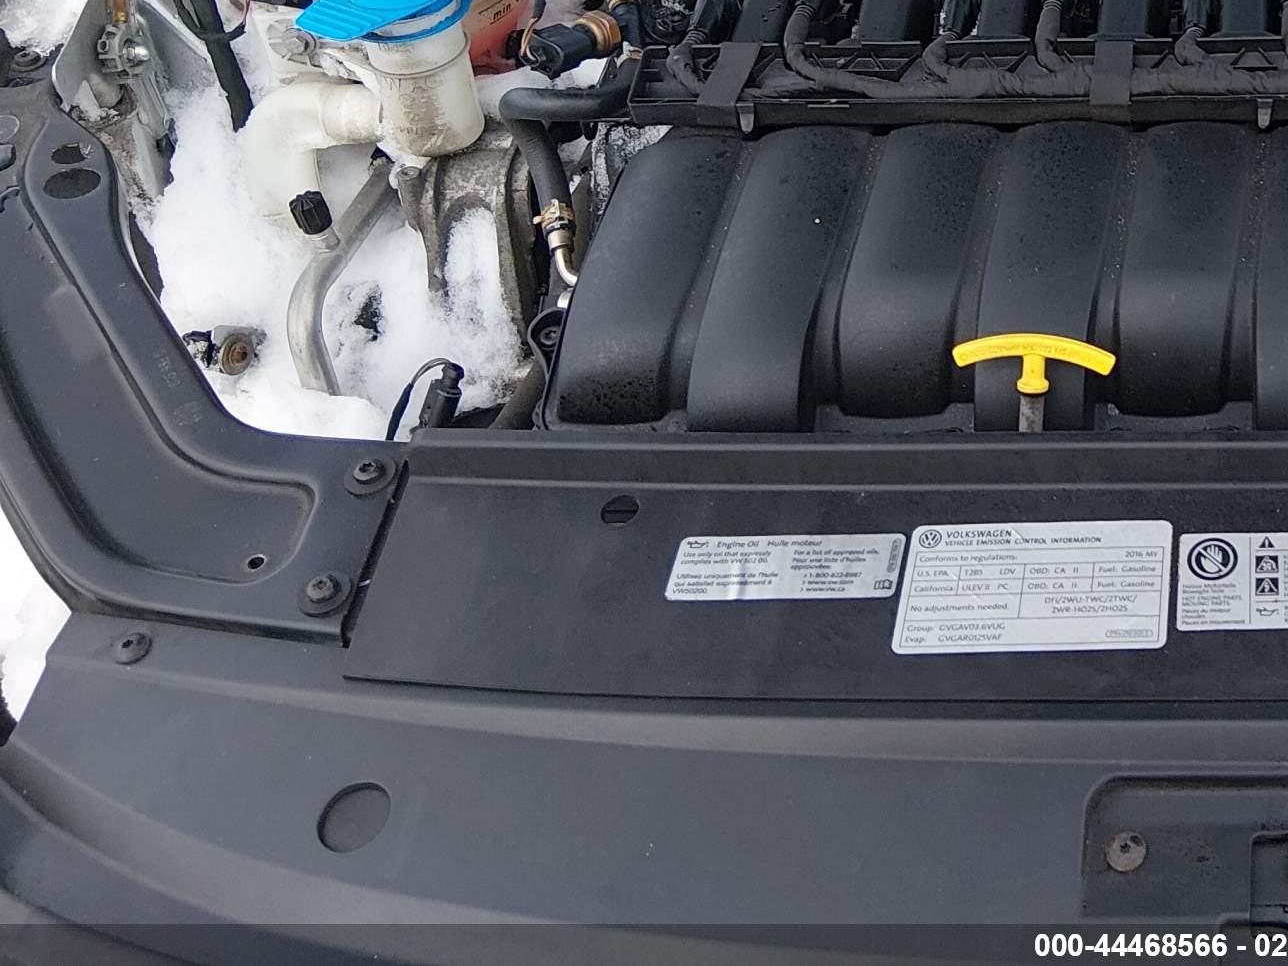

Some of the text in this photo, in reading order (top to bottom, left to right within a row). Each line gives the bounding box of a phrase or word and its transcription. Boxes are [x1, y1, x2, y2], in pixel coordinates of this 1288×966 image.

[492, 3, 512, 20] min
[946, 530, 1012, 538] VOLKSWAGEN
[716, 541, 745, 550] Engine
[924, 604, 975, 613] adjustments
